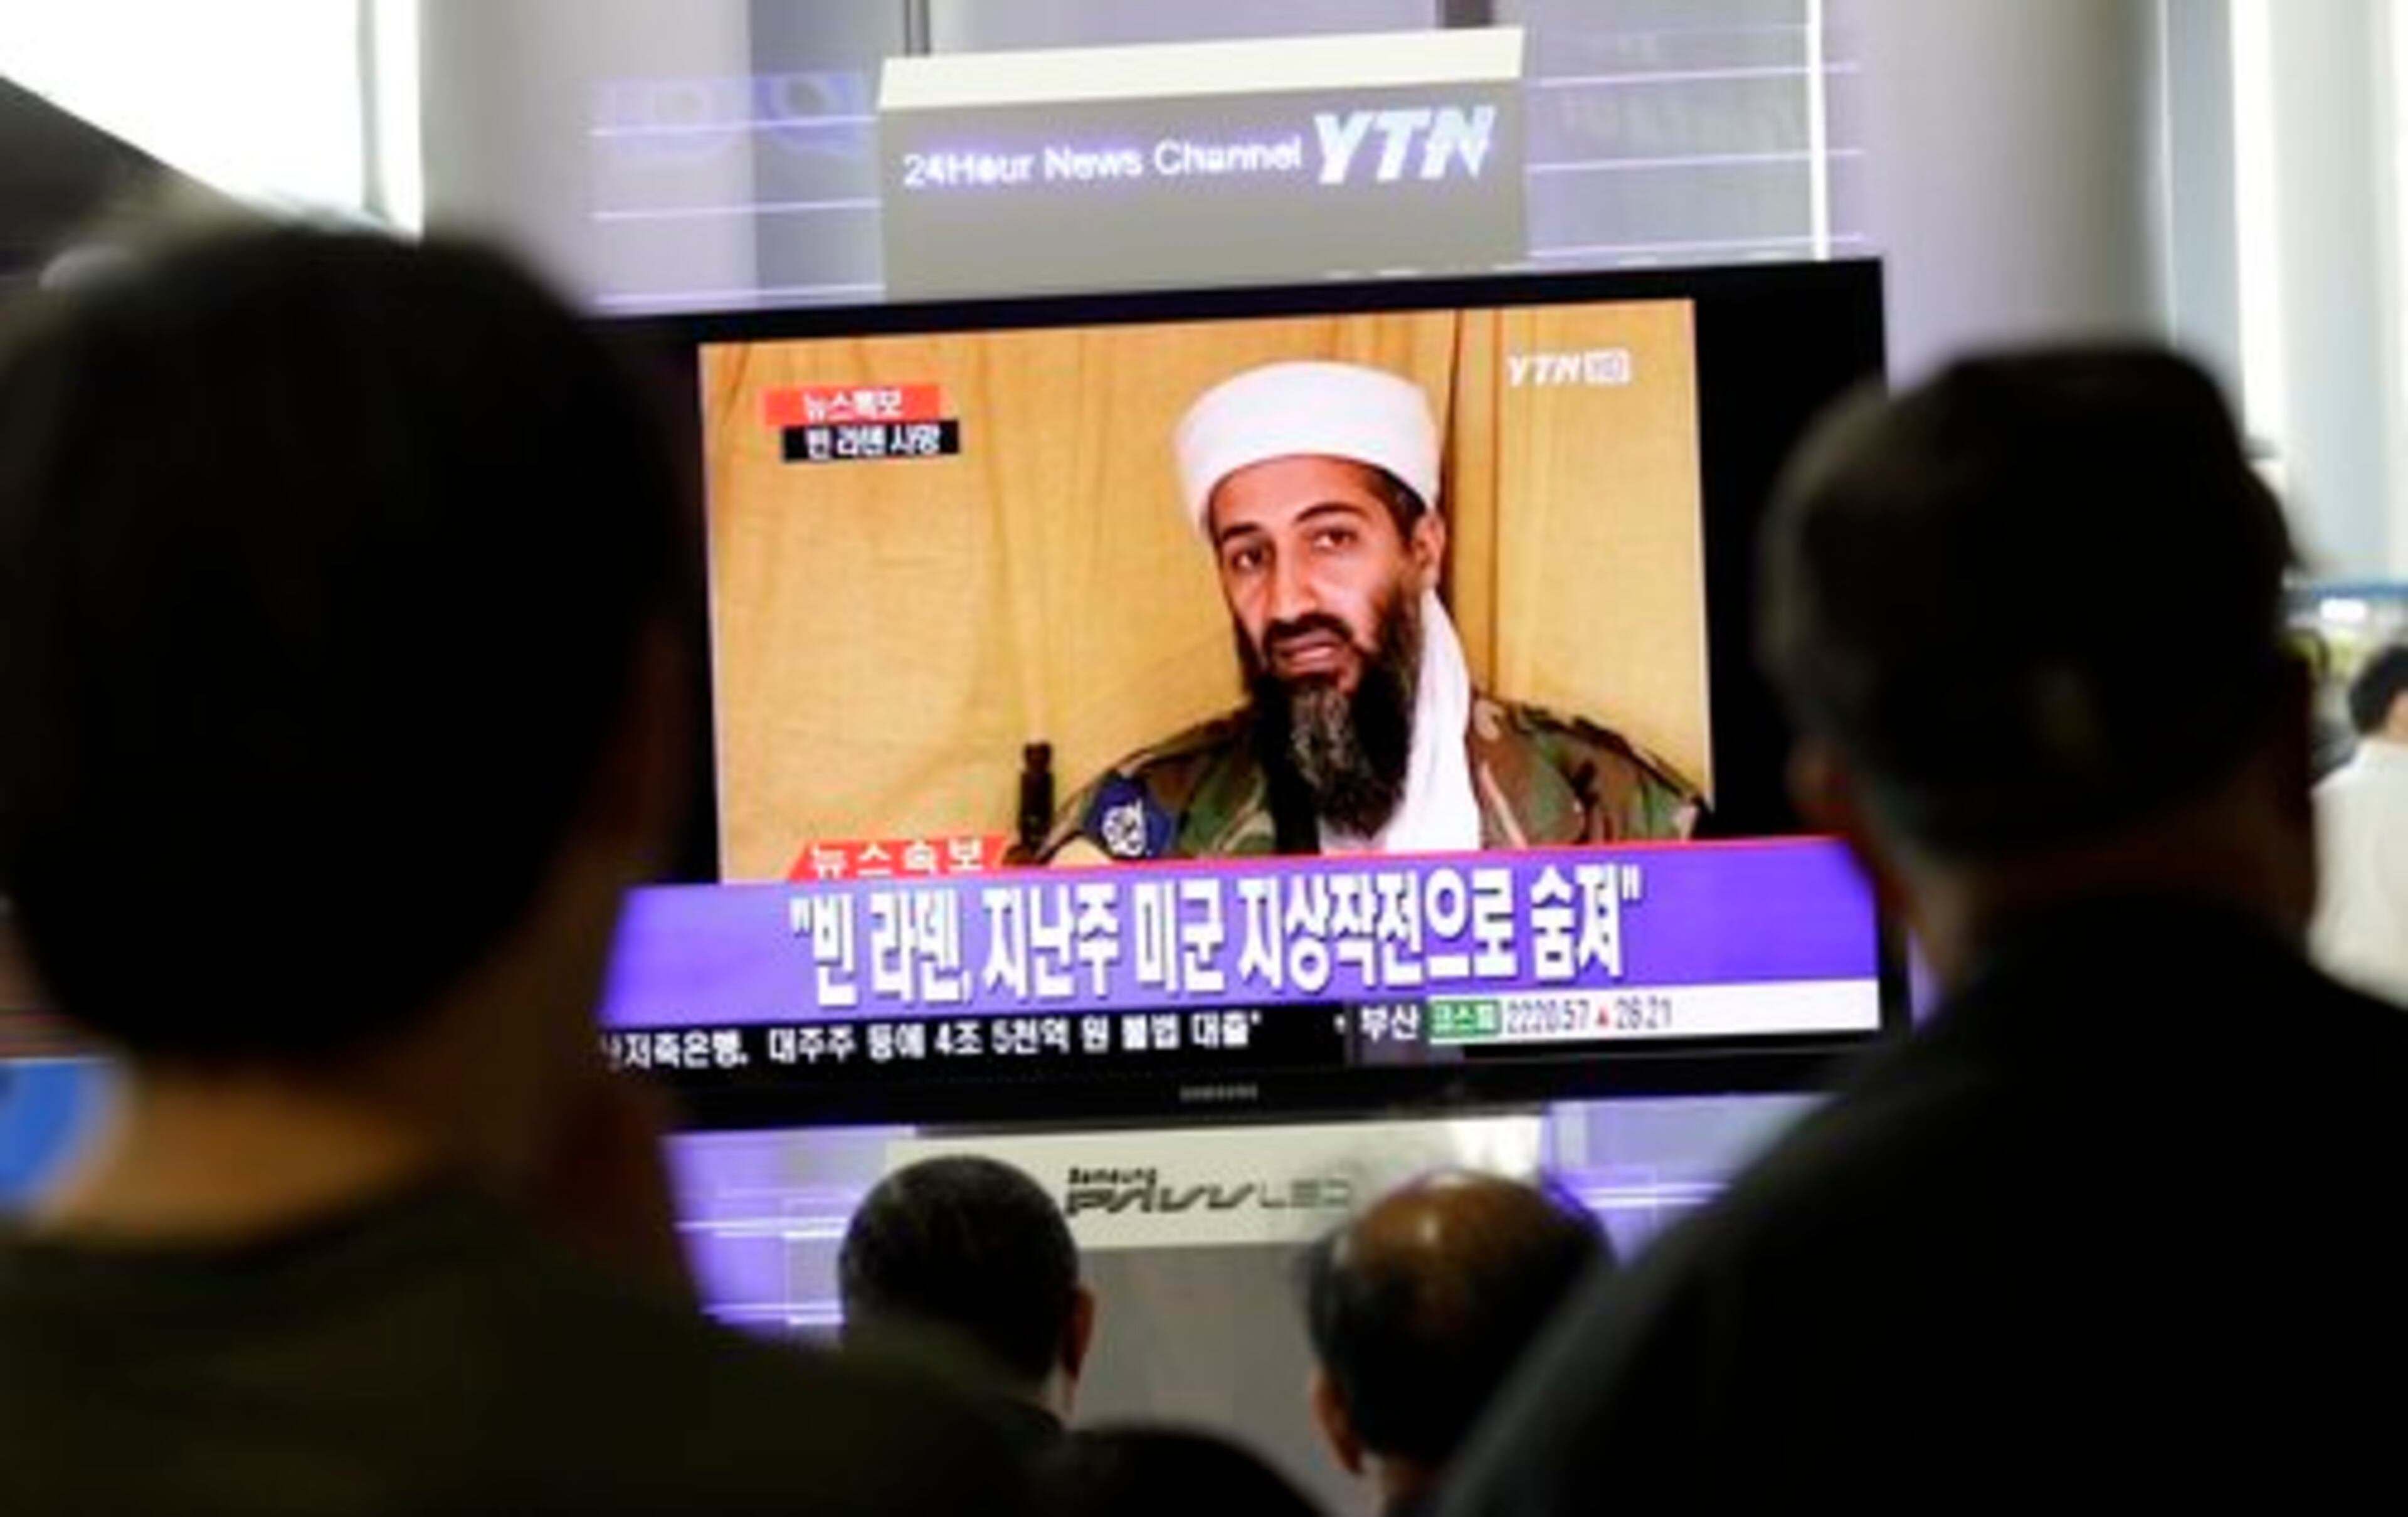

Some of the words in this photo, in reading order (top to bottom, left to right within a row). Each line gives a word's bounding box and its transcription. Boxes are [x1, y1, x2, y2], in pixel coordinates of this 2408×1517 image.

[903, 152, 1032, 188] 24Hour
[1044, 145, 1143, 182] News
[1155, 136, 1302, 176] Channel
[1314, 105, 1496, 184] YTN
[1507, 353, 1581, 388] YTN
[805, 426, 832, 460] 빈
[836, 425, 886, 457] 라덴
[890, 423, 941, 454] 사망
[810, 839, 983, 879] 뉴스속보
[982, 883, 1119, 998] 지난주
[1133, 878, 1225, 993] 미군
[1237, 867, 1518, 994] 지상작전으로
[768, 1025, 857, 1063] 대주주
[867, 1023, 926, 1061] 등에
[935, 1020, 984, 1055] 4조
[991, 1017, 1069, 1055] 5천억
[1082, 1015, 1109, 1053] 원
[1361, 1004, 1420, 1041] 부산
